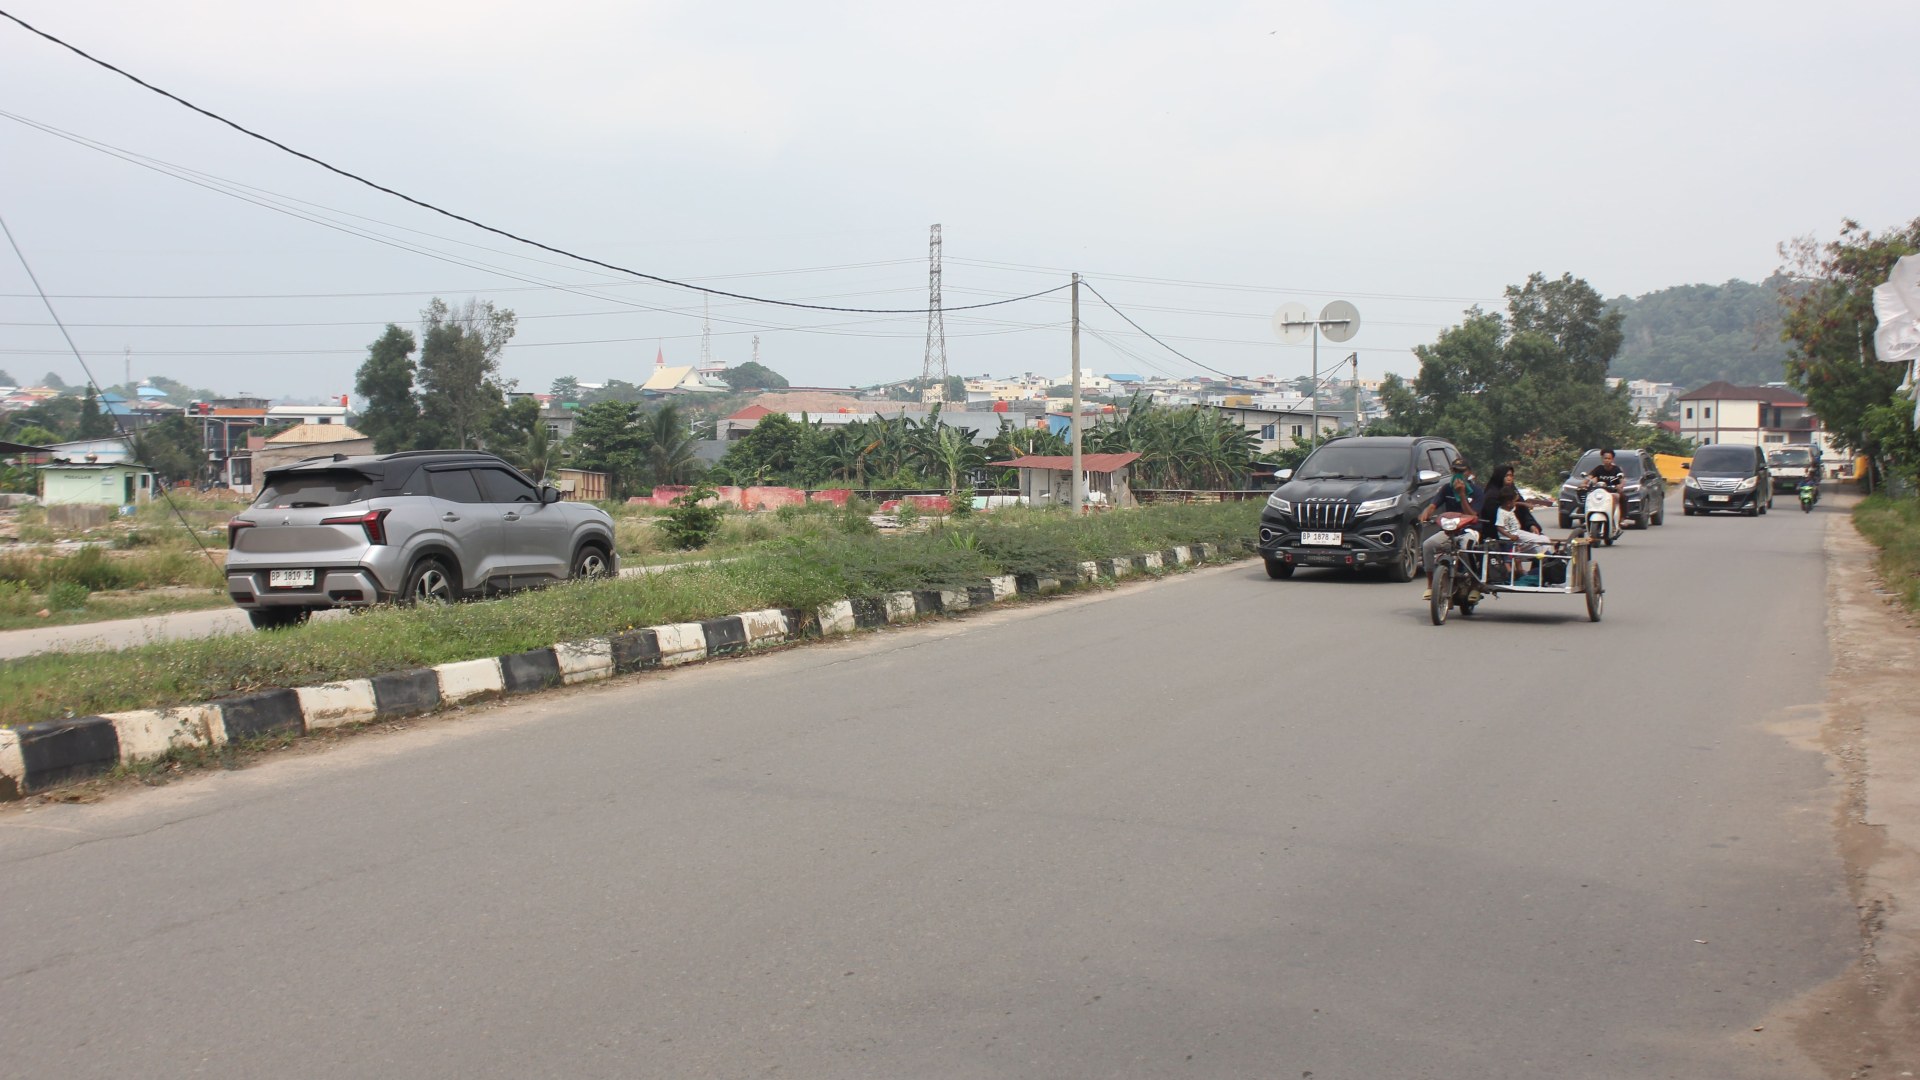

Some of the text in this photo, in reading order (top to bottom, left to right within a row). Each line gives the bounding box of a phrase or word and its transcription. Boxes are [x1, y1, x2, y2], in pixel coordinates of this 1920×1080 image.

[1303, 533, 1310, 541] BP
[1313, 533, 1329, 541] 1878
[271, 570, 313, 581] BP 1819 JE
